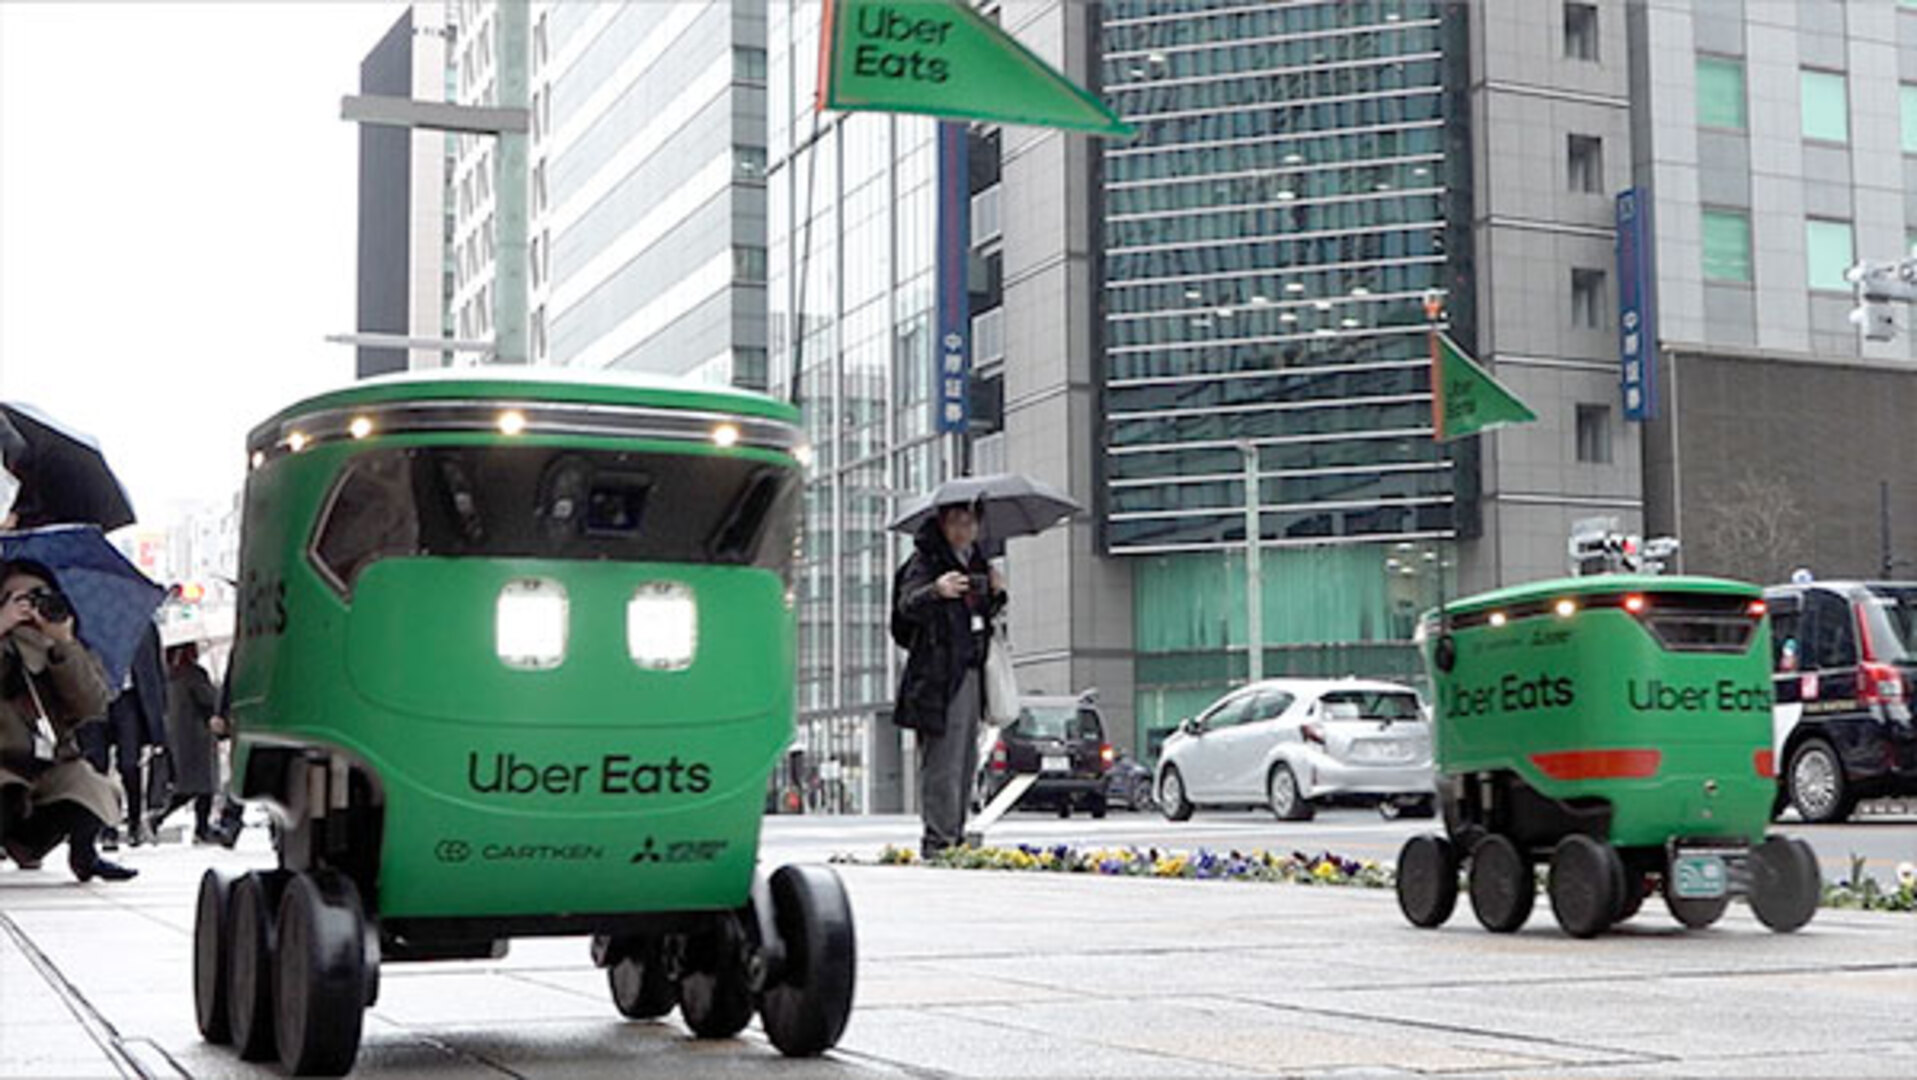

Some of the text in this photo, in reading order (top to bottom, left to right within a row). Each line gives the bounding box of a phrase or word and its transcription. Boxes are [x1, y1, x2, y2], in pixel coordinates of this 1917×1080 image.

[857, 5, 954, 45] Uber
[854, 44, 950, 83] Eats
[1501, 673, 1574, 712] Eats
[1630, 679, 1709, 712] Uber
[468, 752, 711, 794] Uber Eats
[482, 843, 603, 861] CARTKEN
